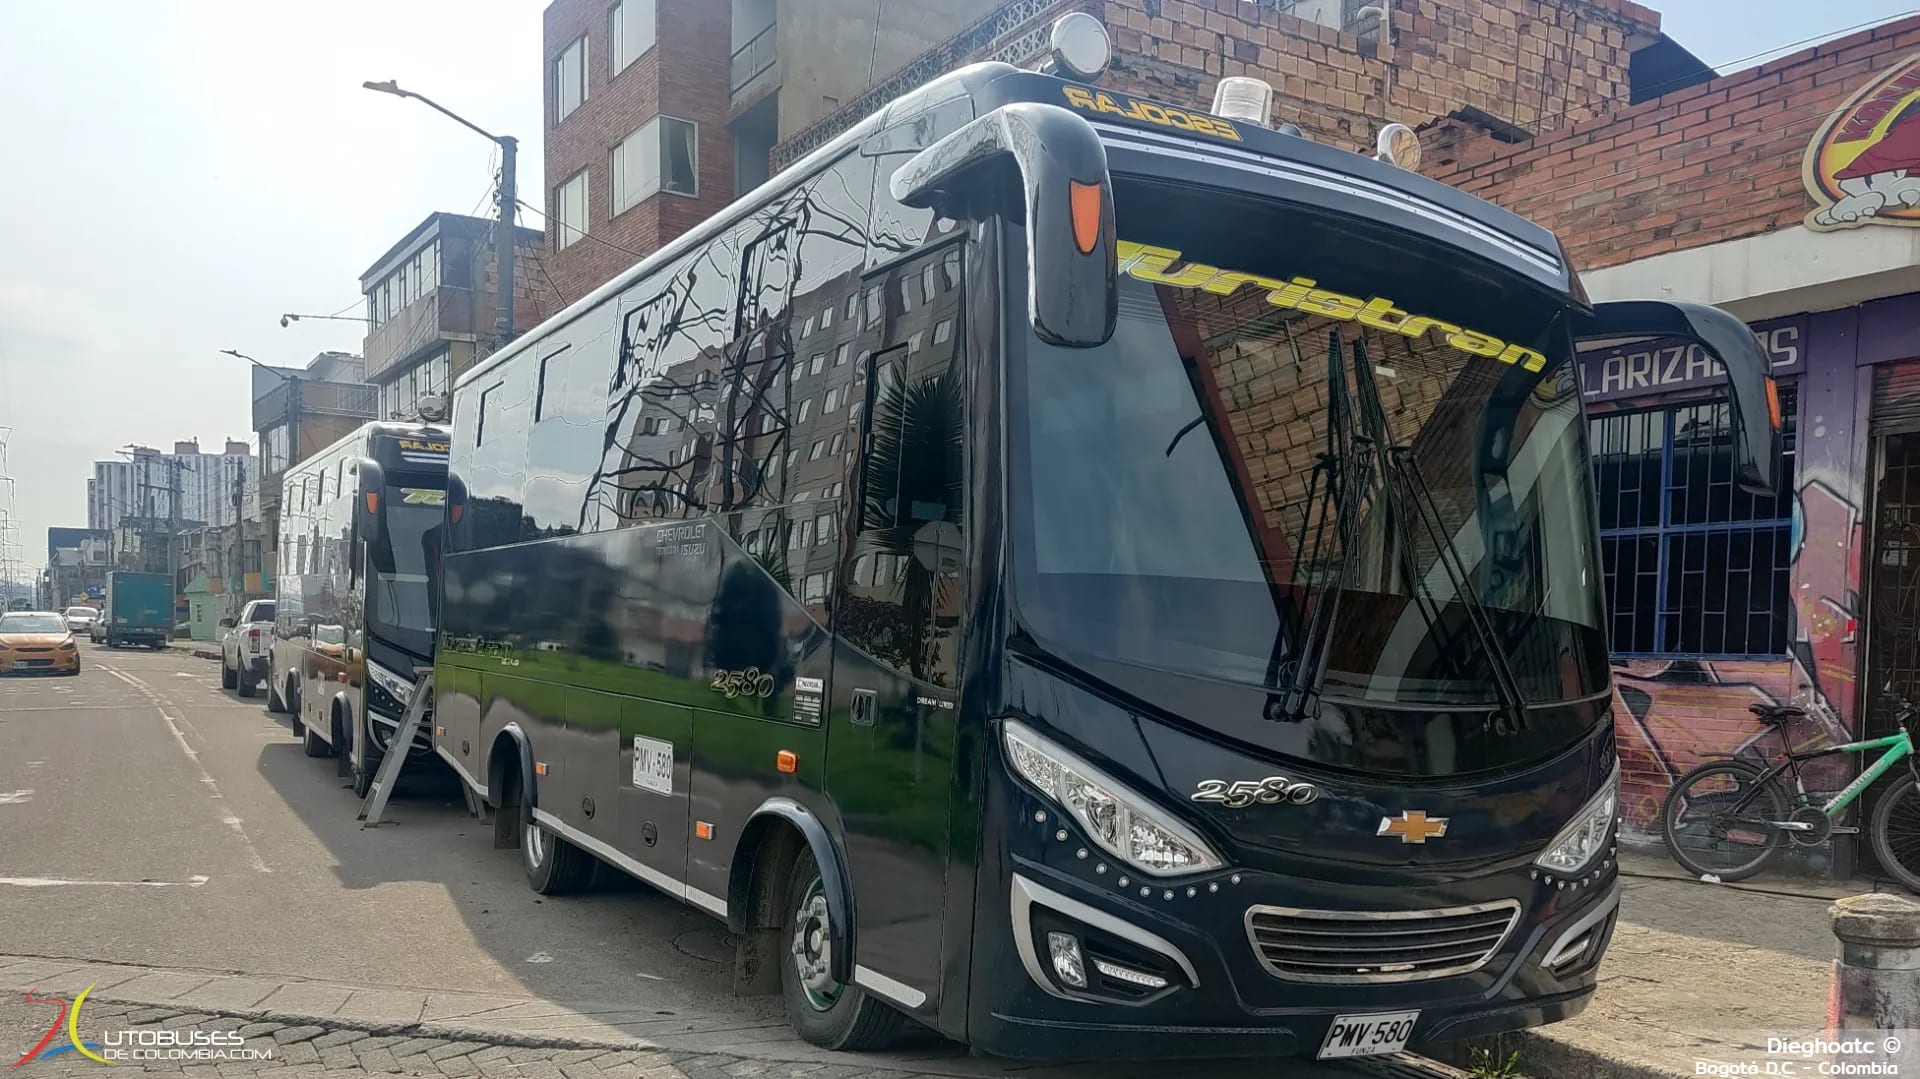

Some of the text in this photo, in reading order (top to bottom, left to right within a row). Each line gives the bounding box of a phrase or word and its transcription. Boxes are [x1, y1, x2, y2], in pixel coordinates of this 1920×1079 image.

[656, 523, 706, 543] CHEVROLET
[680, 543, 706, 557] ISUZU
[710, 667, 775, 698] 2580
[1191, 776, 1319, 808] 2580
